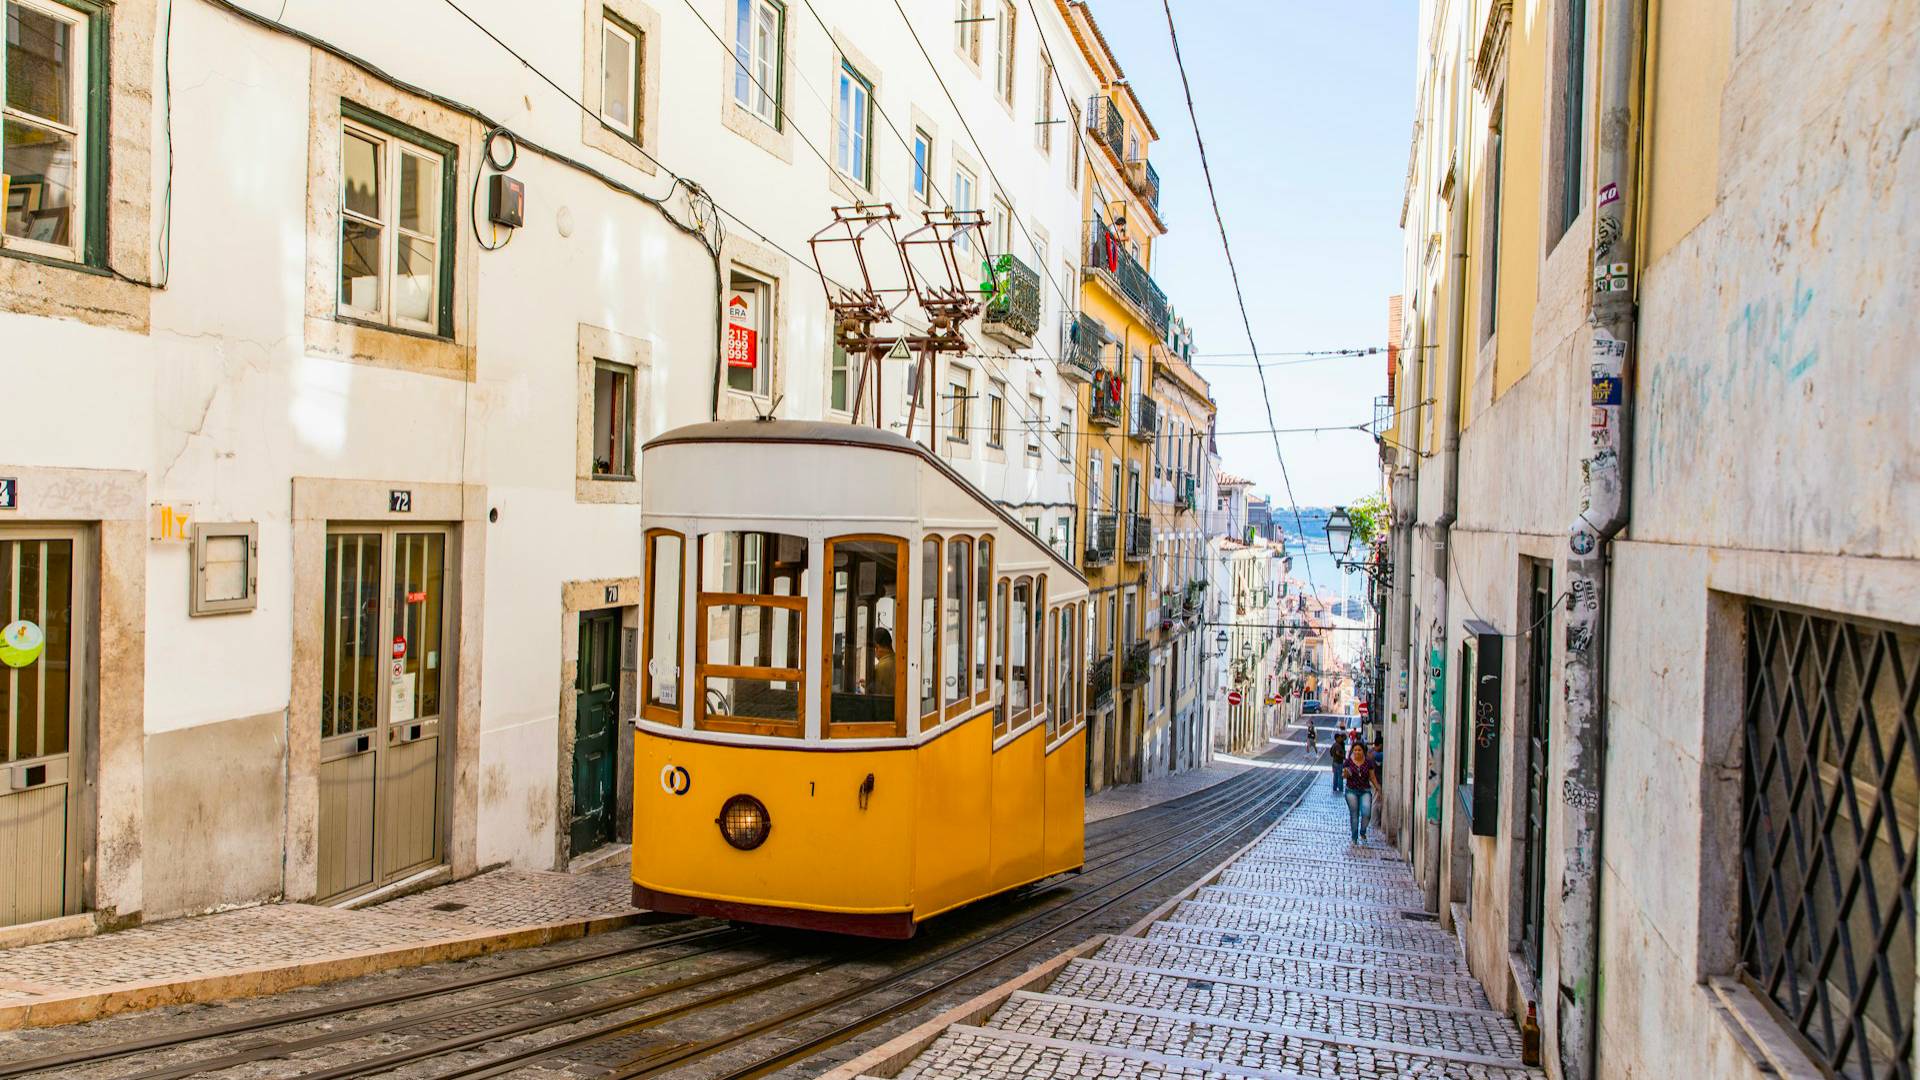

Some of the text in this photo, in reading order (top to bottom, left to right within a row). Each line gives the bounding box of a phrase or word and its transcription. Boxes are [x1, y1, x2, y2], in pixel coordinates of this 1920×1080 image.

[729, 308, 746, 316] ERA
[729, 329, 748, 340] 215
[729, 340, 748, 350] 999
[729, 350, 748, 360] 995
[394, 492, 408, 511] 72
[608, 587, 618, 602] 70
